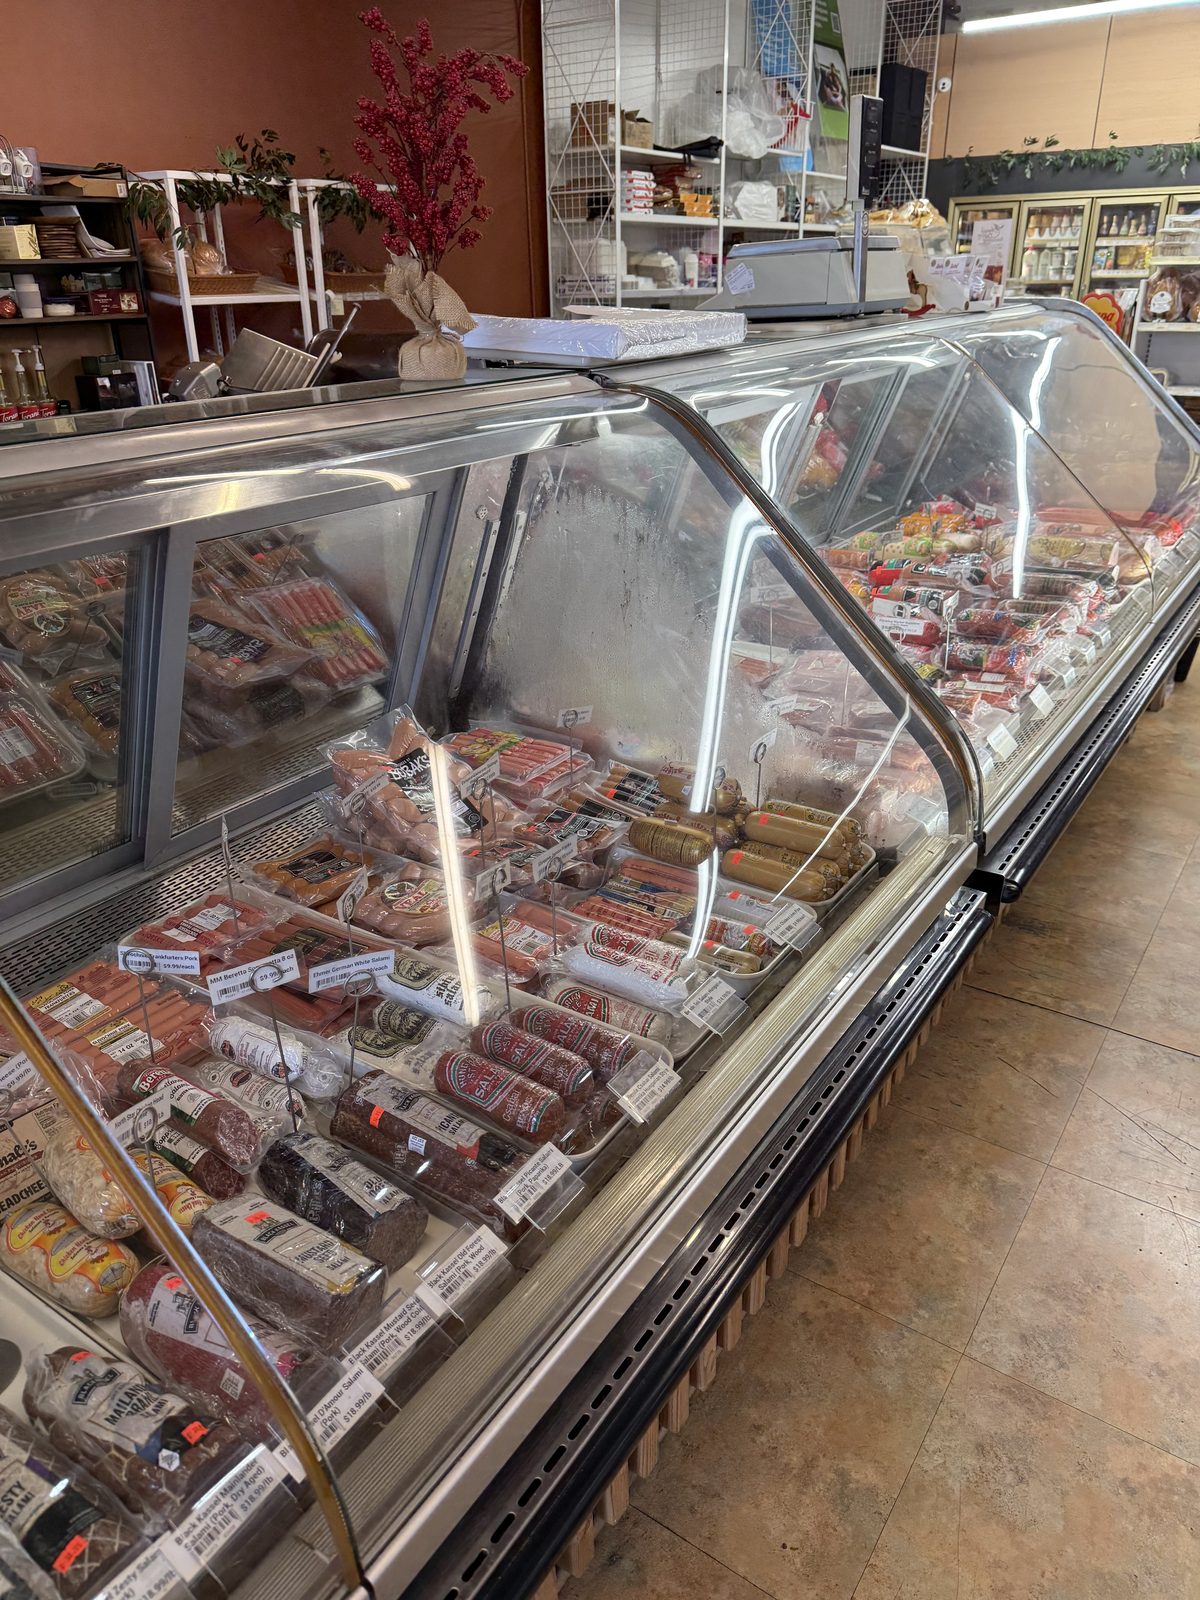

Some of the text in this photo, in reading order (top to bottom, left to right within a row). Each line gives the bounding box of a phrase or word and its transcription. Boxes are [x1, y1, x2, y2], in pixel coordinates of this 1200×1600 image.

[210, 970, 244, 984] MM Beretta
[332, 963, 354, 973] German
[7, 1067, 32, 1089] $9.99/lb
[295, 1240, 335, 1264] MUSTARD
[440, 1258, 459, 1276] Kassel
[457, 1249, 468, 1260] Old
[466, 1235, 483, 1252] Forest
[473, 1248, 497, 1273] $18.99/lb
[438, 1245, 485, 1291] Salami (Pork, Wood
[364, 1329, 385, 1350] Kassel
[383, 1309, 408, 1332] Mustard
[378, 1333, 397, 1350] (Pork,
[394, 1318, 412, 1334] Wood
[404, 1314, 432, 1341] $18.99/lb
[317, 1390, 344, 1416] D'Amour
[342, 1367, 364, 1391] Salami
[343, 1391, 373, 1423] $18.99/lb
[320, 1406, 341, 1428] (Pork)
[196, 1498, 222, 1523] Kassel
[219, 1458, 258, 1499] Mainlander
[240, 1476, 274, 1512] $18.99/lb
[184, 1466, 266, 1550] Salami (Pork, Dry Aged)
[112, 1572, 138, 1596] Zesty
[141, 1569, 177, 1600] 18.99/lb
